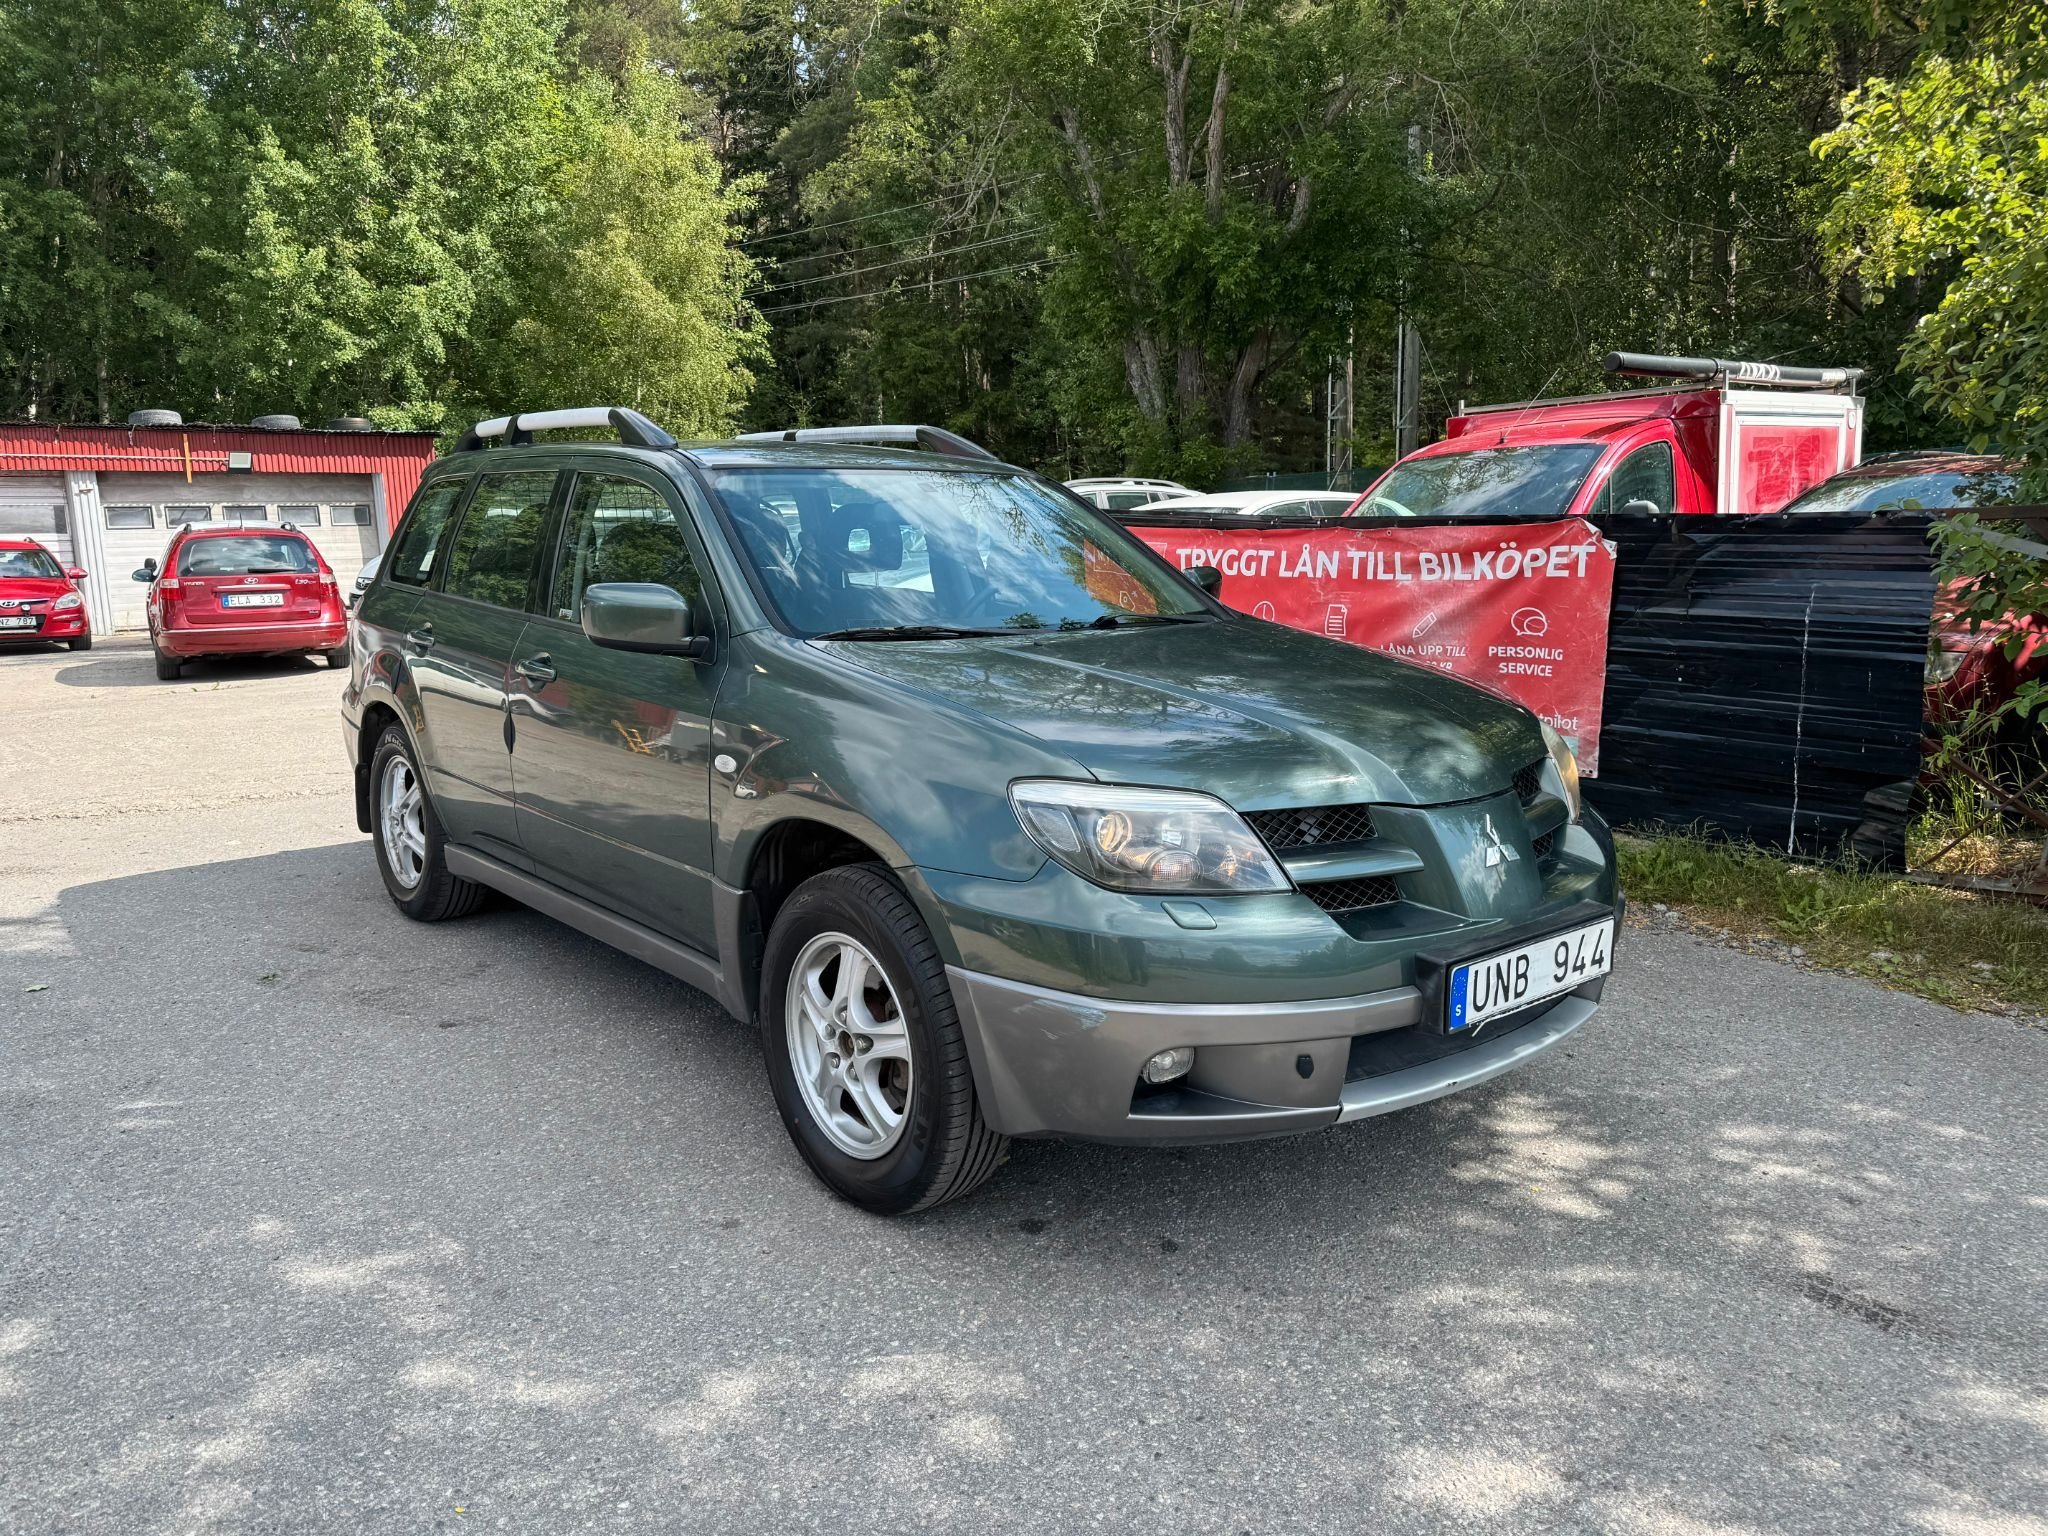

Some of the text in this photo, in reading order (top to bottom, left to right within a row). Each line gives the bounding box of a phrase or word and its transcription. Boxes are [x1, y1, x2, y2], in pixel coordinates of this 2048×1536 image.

[1176, 541, 1597, 581] TRYGGT LÅN TILL BILKÖPET
[230, 595, 250, 605] ELA
[259, 594, 281, 604] 332
[16, 617, 34, 625] 787
[1418, 645, 1443, 656] UPP
[1446, 646, 1467, 657] TILL
[1488, 646, 1564, 661] PERSONLIG
[1498, 663, 1553, 677] SERVICE
[1472, 928, 1605, 1013] UNB 944
[1455, 1004, 1462, 1017] S
